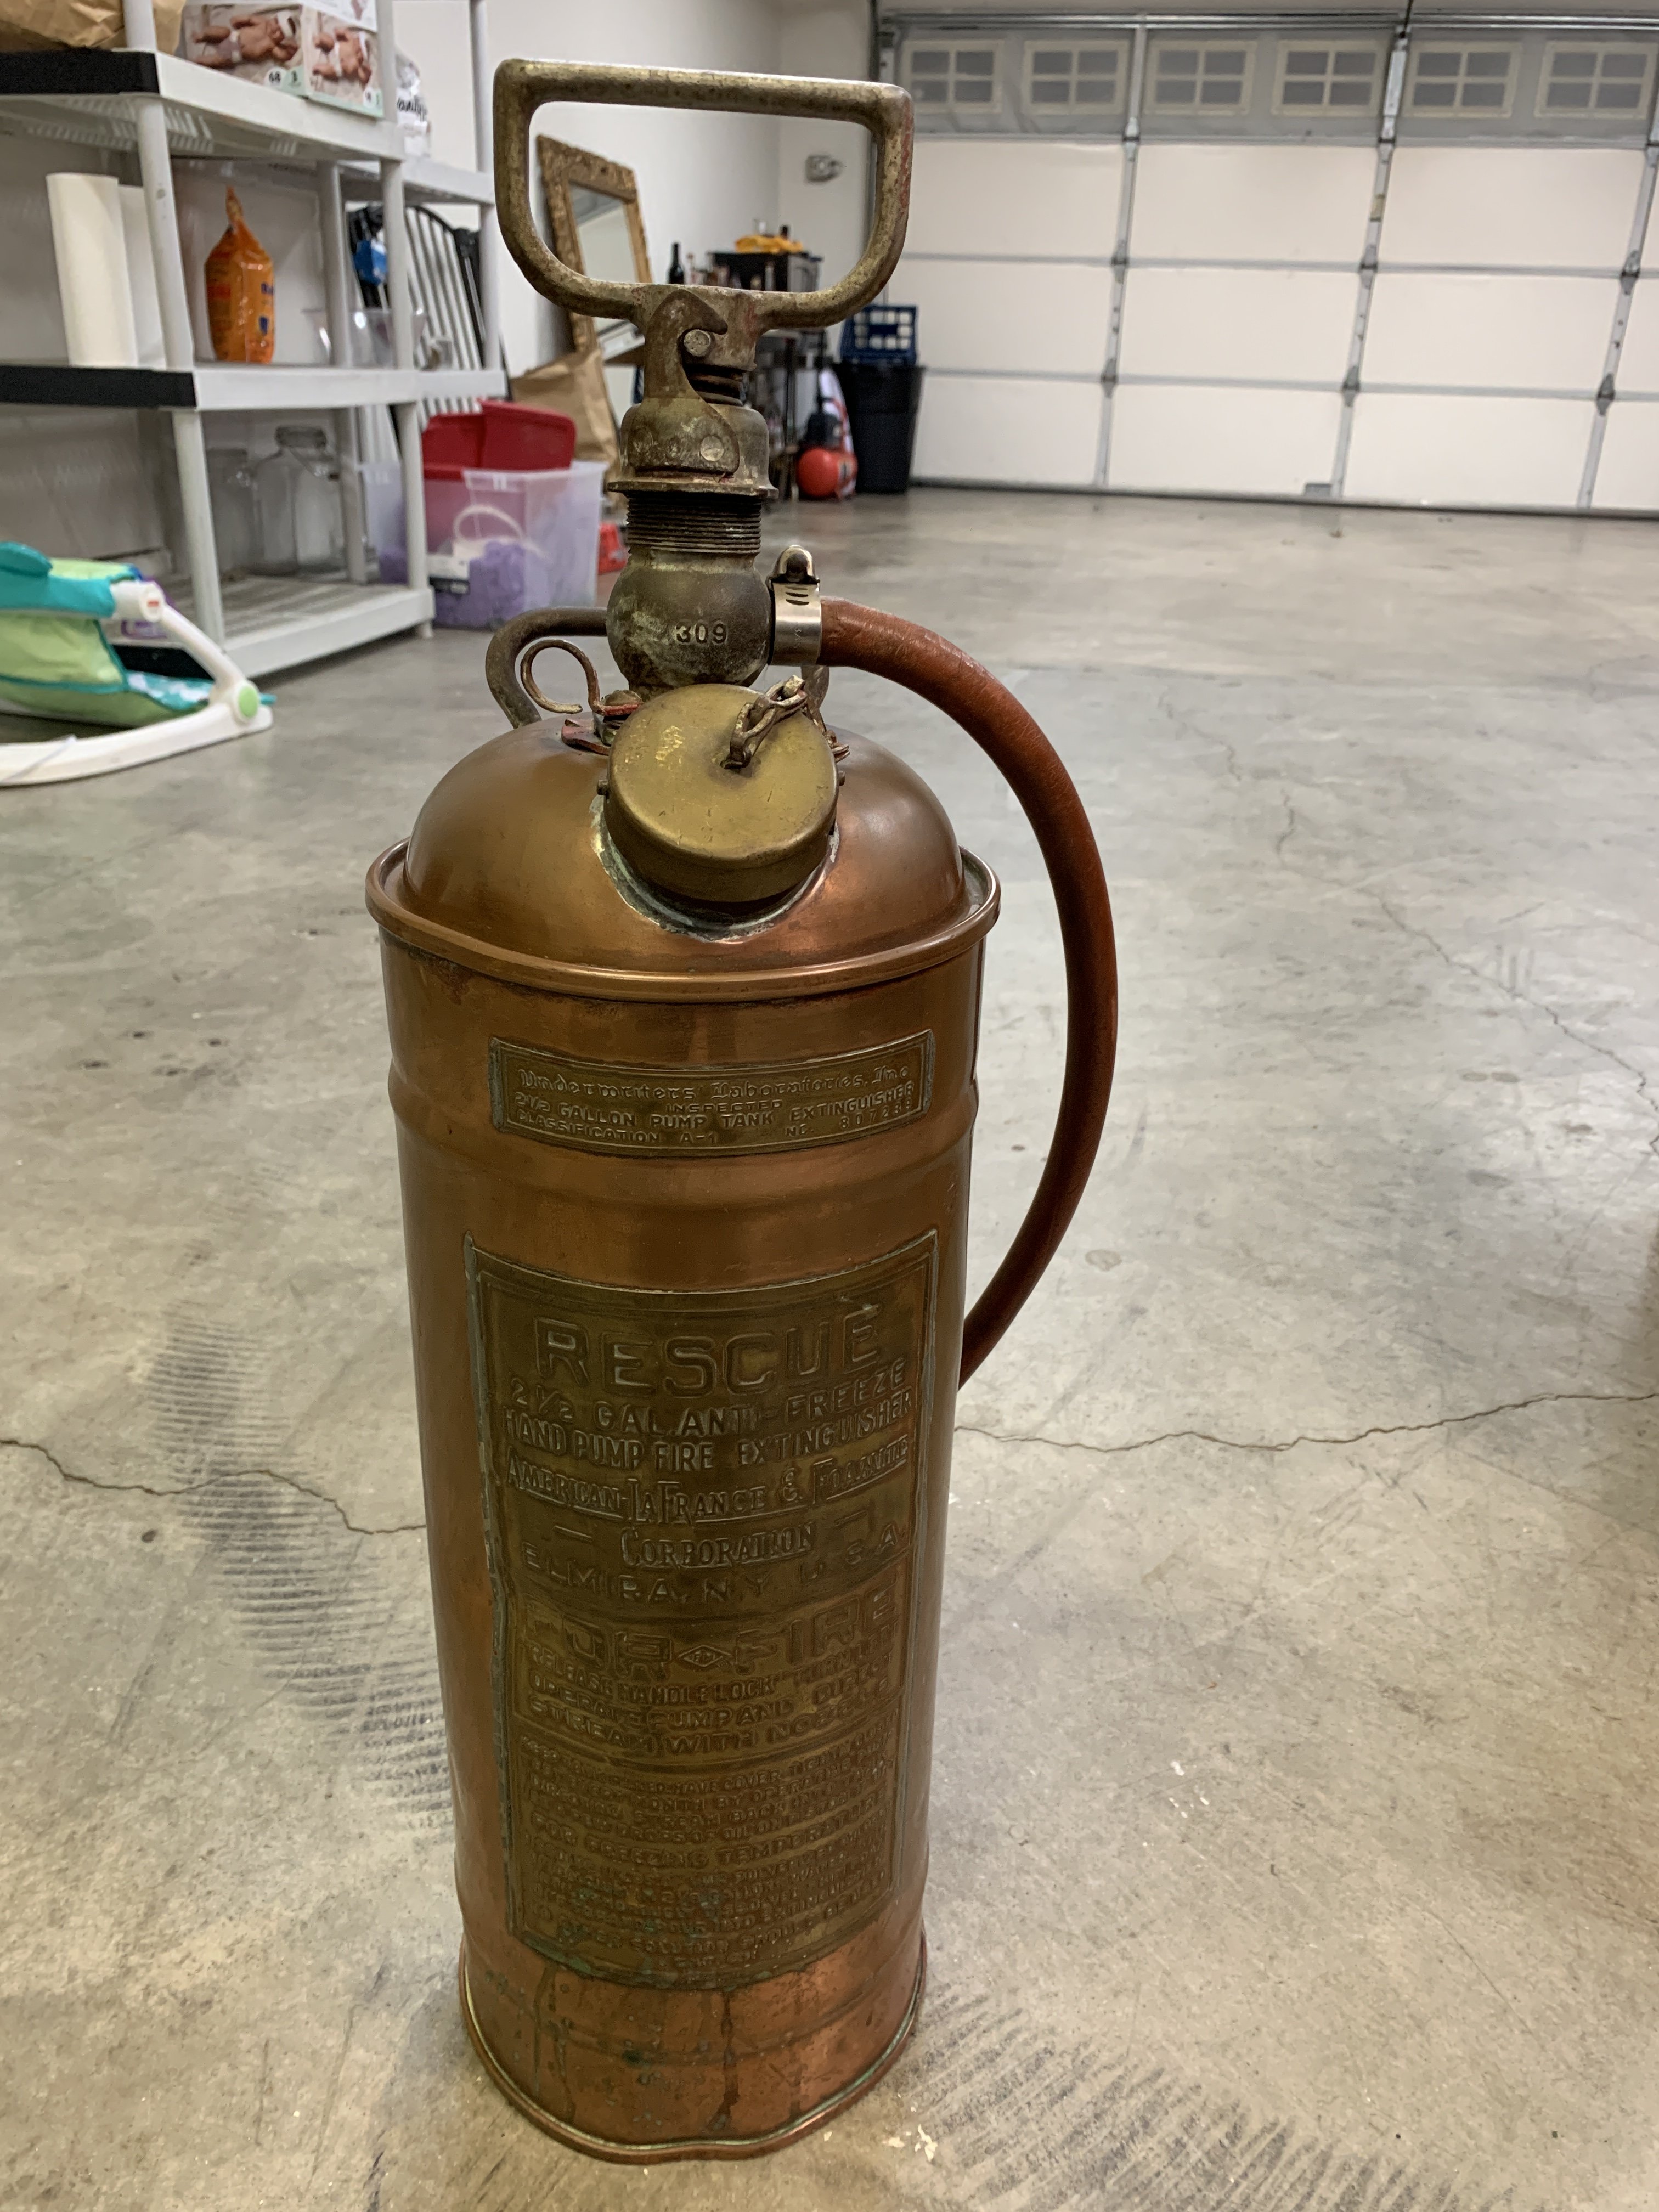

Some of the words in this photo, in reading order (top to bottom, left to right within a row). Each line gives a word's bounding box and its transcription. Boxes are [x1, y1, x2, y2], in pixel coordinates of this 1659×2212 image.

[675, 620, 728, 644] 309
[557, 1102, 636, 1127] GALLON
[649, 1113, 708, 1130] PUMP
[720, 1111, 775, 1129] TANK
[791, 1080, 915, 1122] EXTINGUISHER
[665, 1099, 783, 1114] INSPECTED
[517, 1108, 661, 1143] CLASSIFICATION
[534, 1305, 882, 1398] RESCUE
[503, 1401, 566, 1458] HAND
[573, 1427, 644, 1472] PUMP
[654, 1441, 714, 1472] FIRE
[736, 1386, 913, 1469] EXTINGUISHER
[619, 1514, 815, 1571] CORPORATION
[713, 1672, 776, 1703] LOCK
[646, 1707, 732, 1732] PUMP
[735, 1694, 795, 1727] AND
[663, 1727, 759, 1754] WITH
